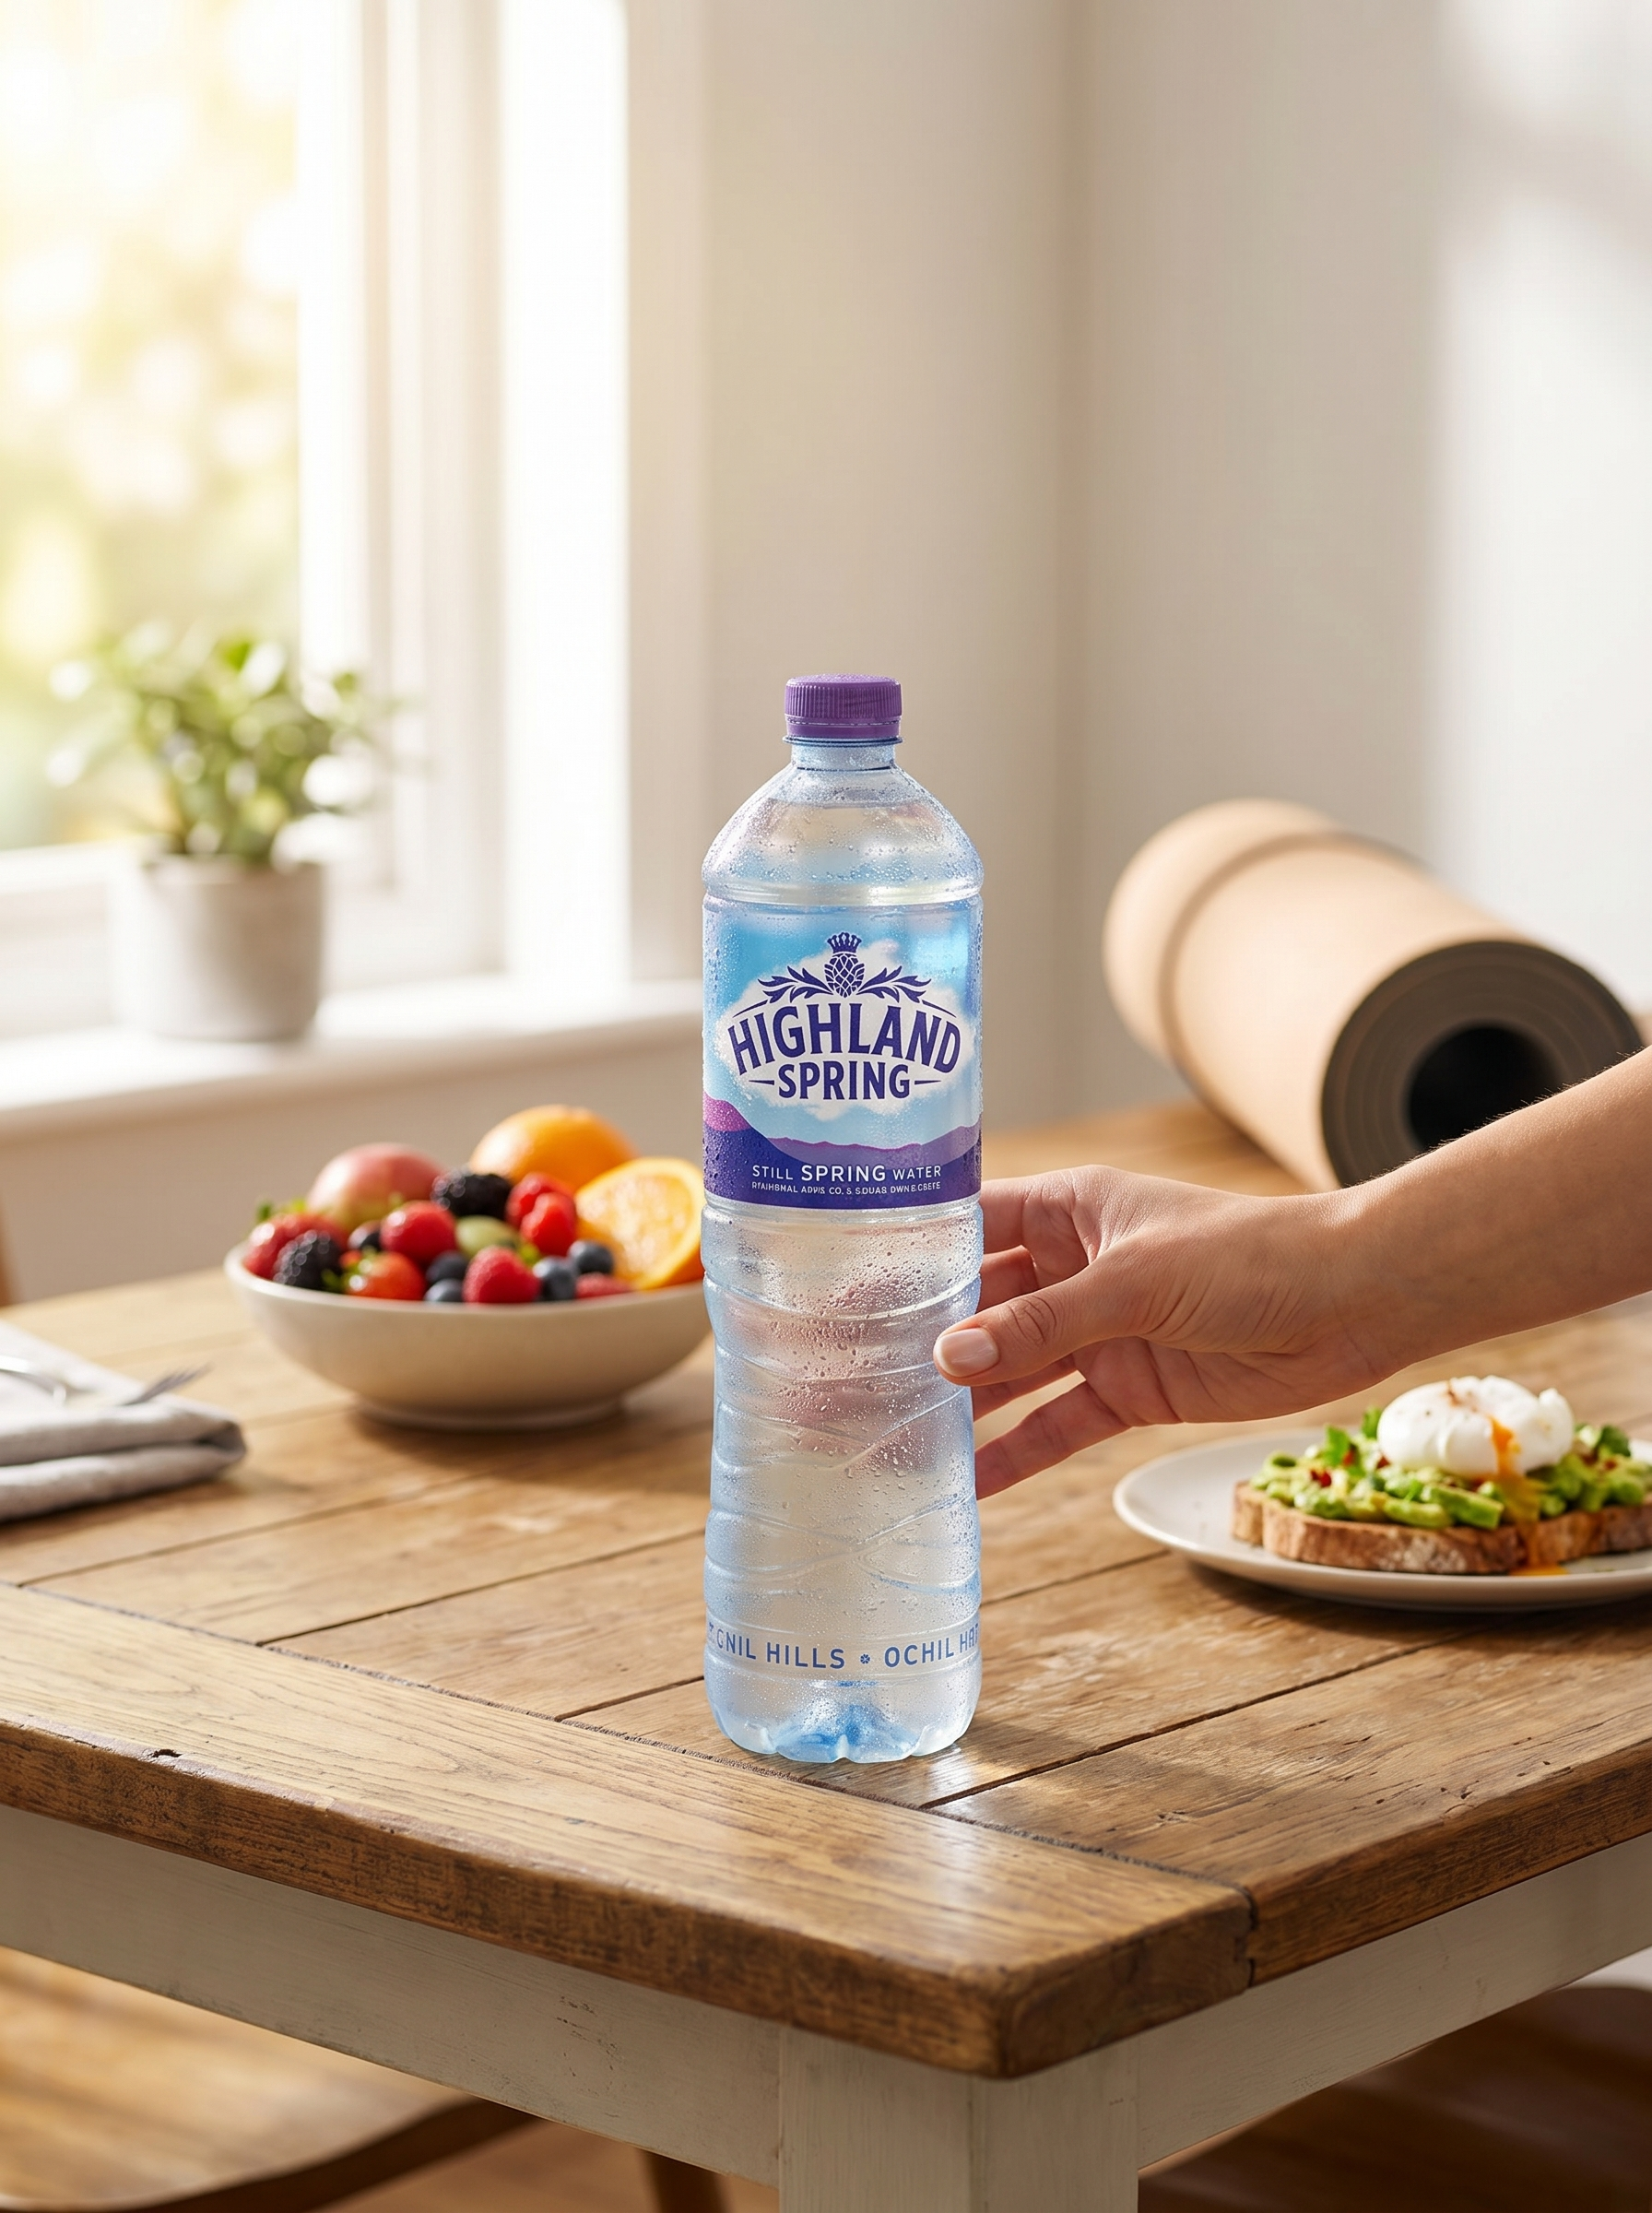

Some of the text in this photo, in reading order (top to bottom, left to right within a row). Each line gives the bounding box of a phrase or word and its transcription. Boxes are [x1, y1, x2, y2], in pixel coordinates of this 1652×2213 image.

[727, 1002, 961, 1076] HIGHLAND
[778, 1060, 910, 1100] SPRING
[752, 1165, 941, 1182] STILL SPRING WATER
[767, 1641, 845, 1669] HILLS
[884, 1638, 954, 1668] OCHIL
